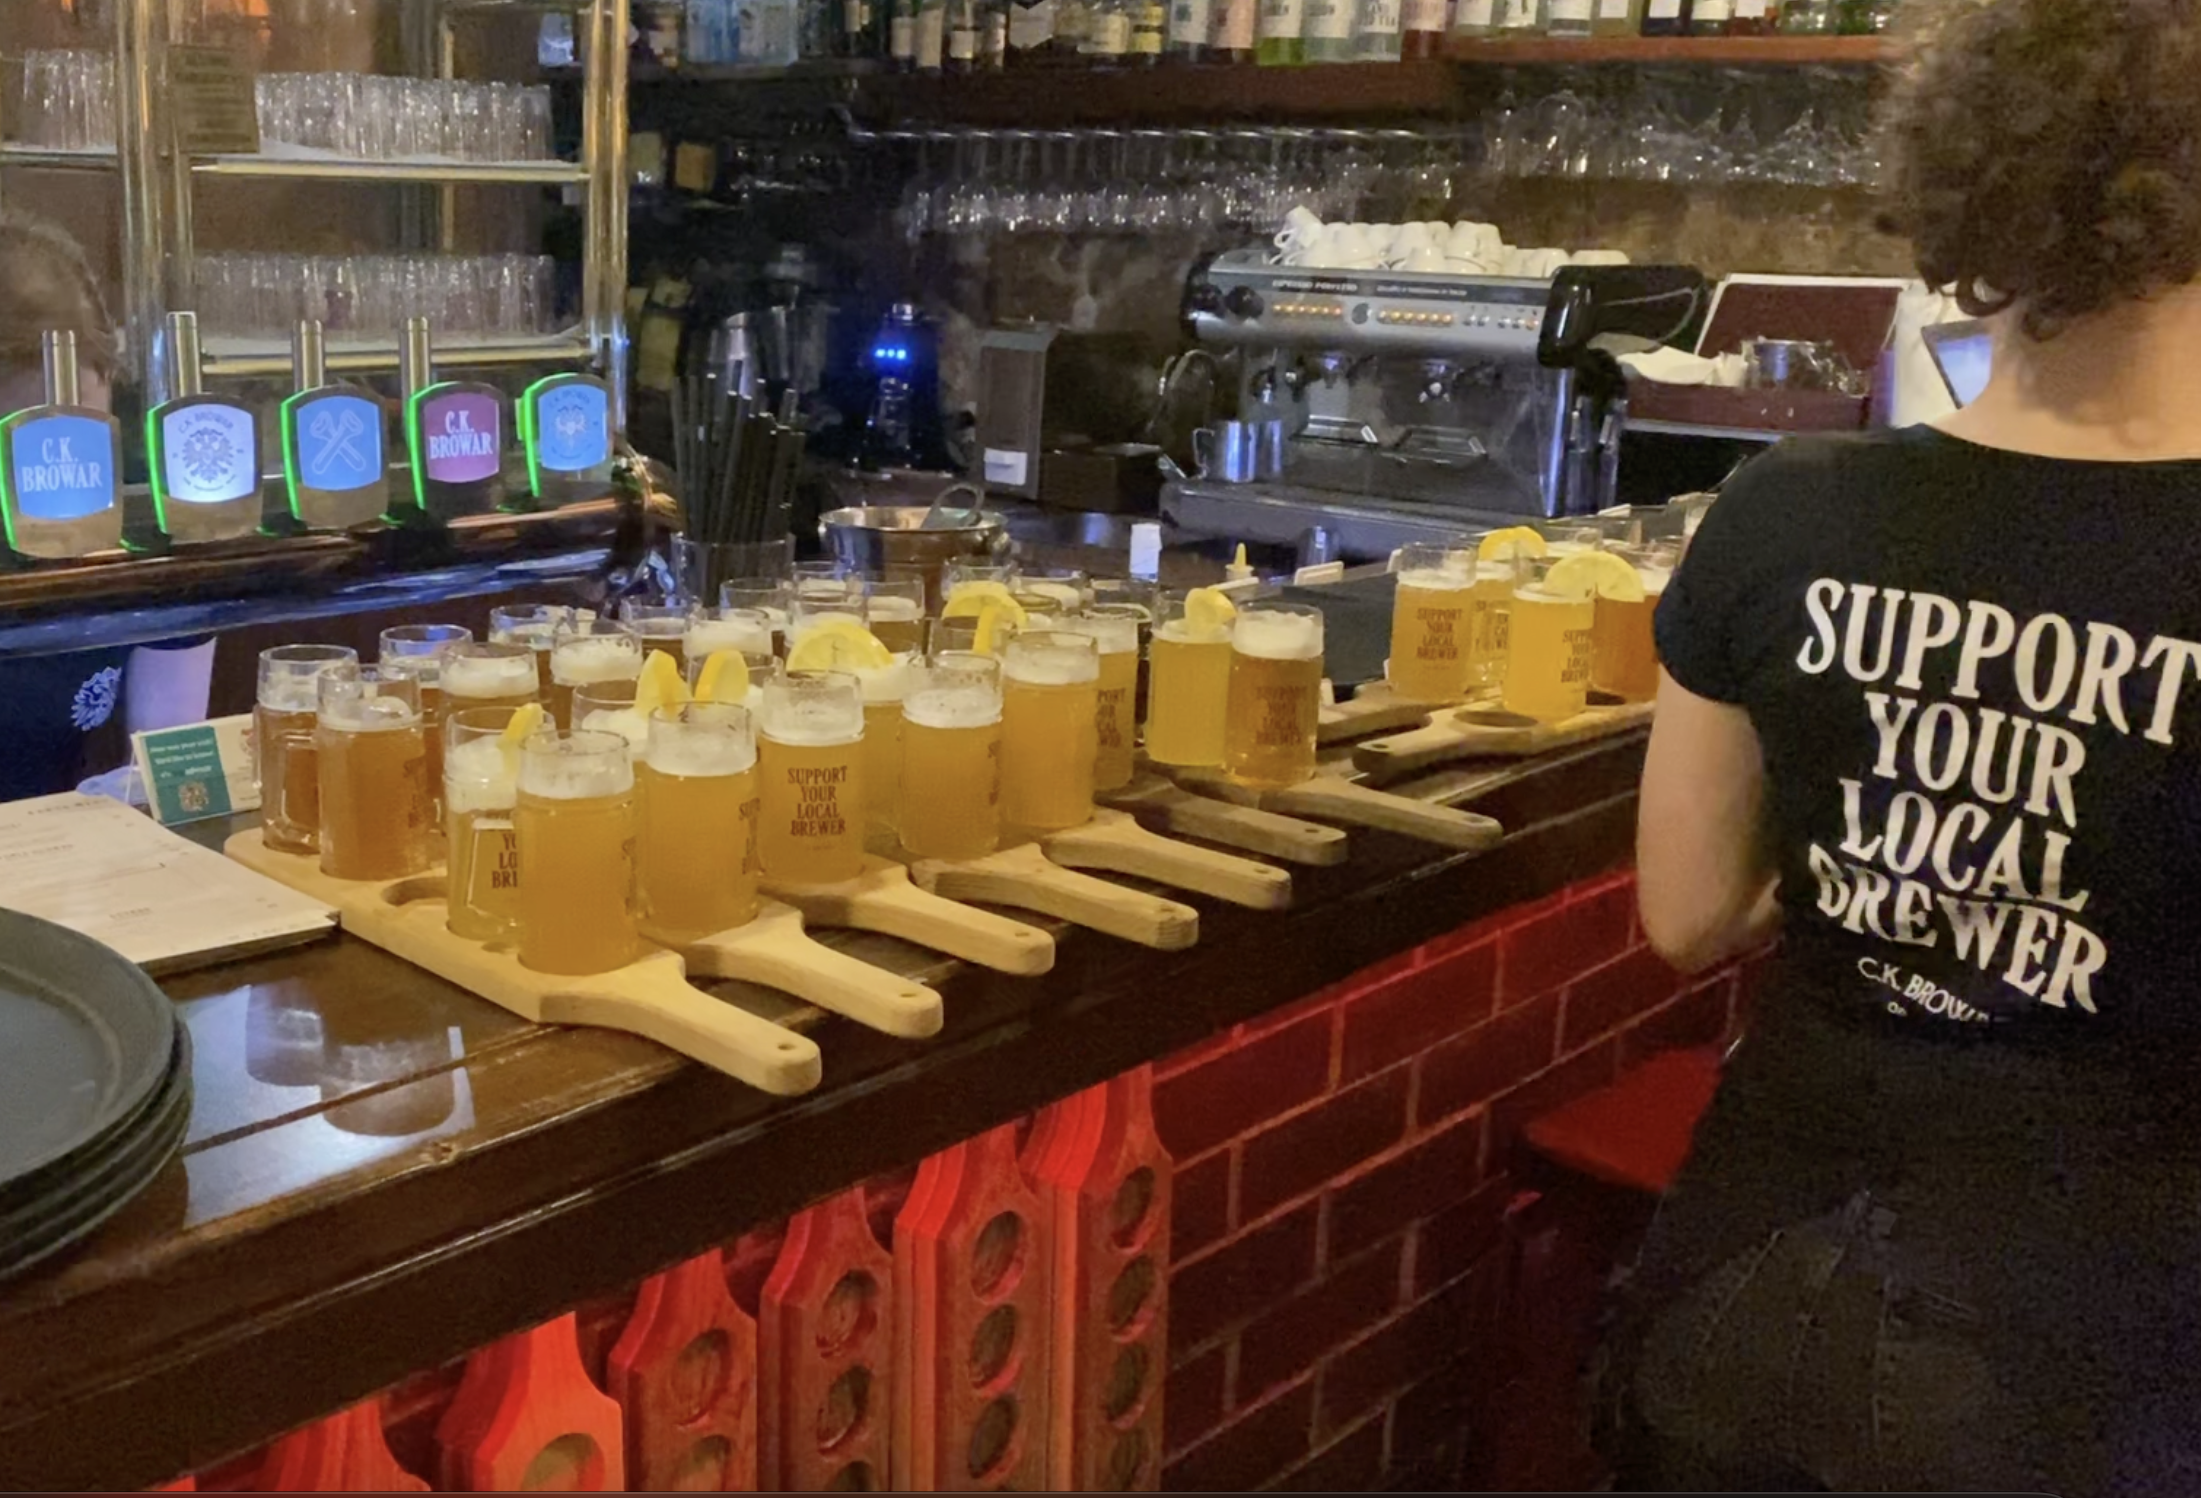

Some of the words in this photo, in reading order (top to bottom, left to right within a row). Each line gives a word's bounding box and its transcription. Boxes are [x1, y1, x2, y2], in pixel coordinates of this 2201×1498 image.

[445, 410, 474, 434] C.K.
[41, 436, 79, 464] C.K.
[429, 431, 493, 459] BROWAR
[21, 461, 103, 493] BROWAR
[1416, 607, 1462, 621] SUPPORT
[1796, 577, 2201, 745] SUPPORT
[1864, 692, 2087, 828] YOUR
[787, 764, 849, 785] SUPPORT
[800, 785, 837, 803] YOUR
[796, 802, 840, 820] LOCAL
[790, 818, 846, 837] BREWER
[1838, 778, 2090, 912] LOCAL
[1808, 843, 2108, 1014] BREWER
